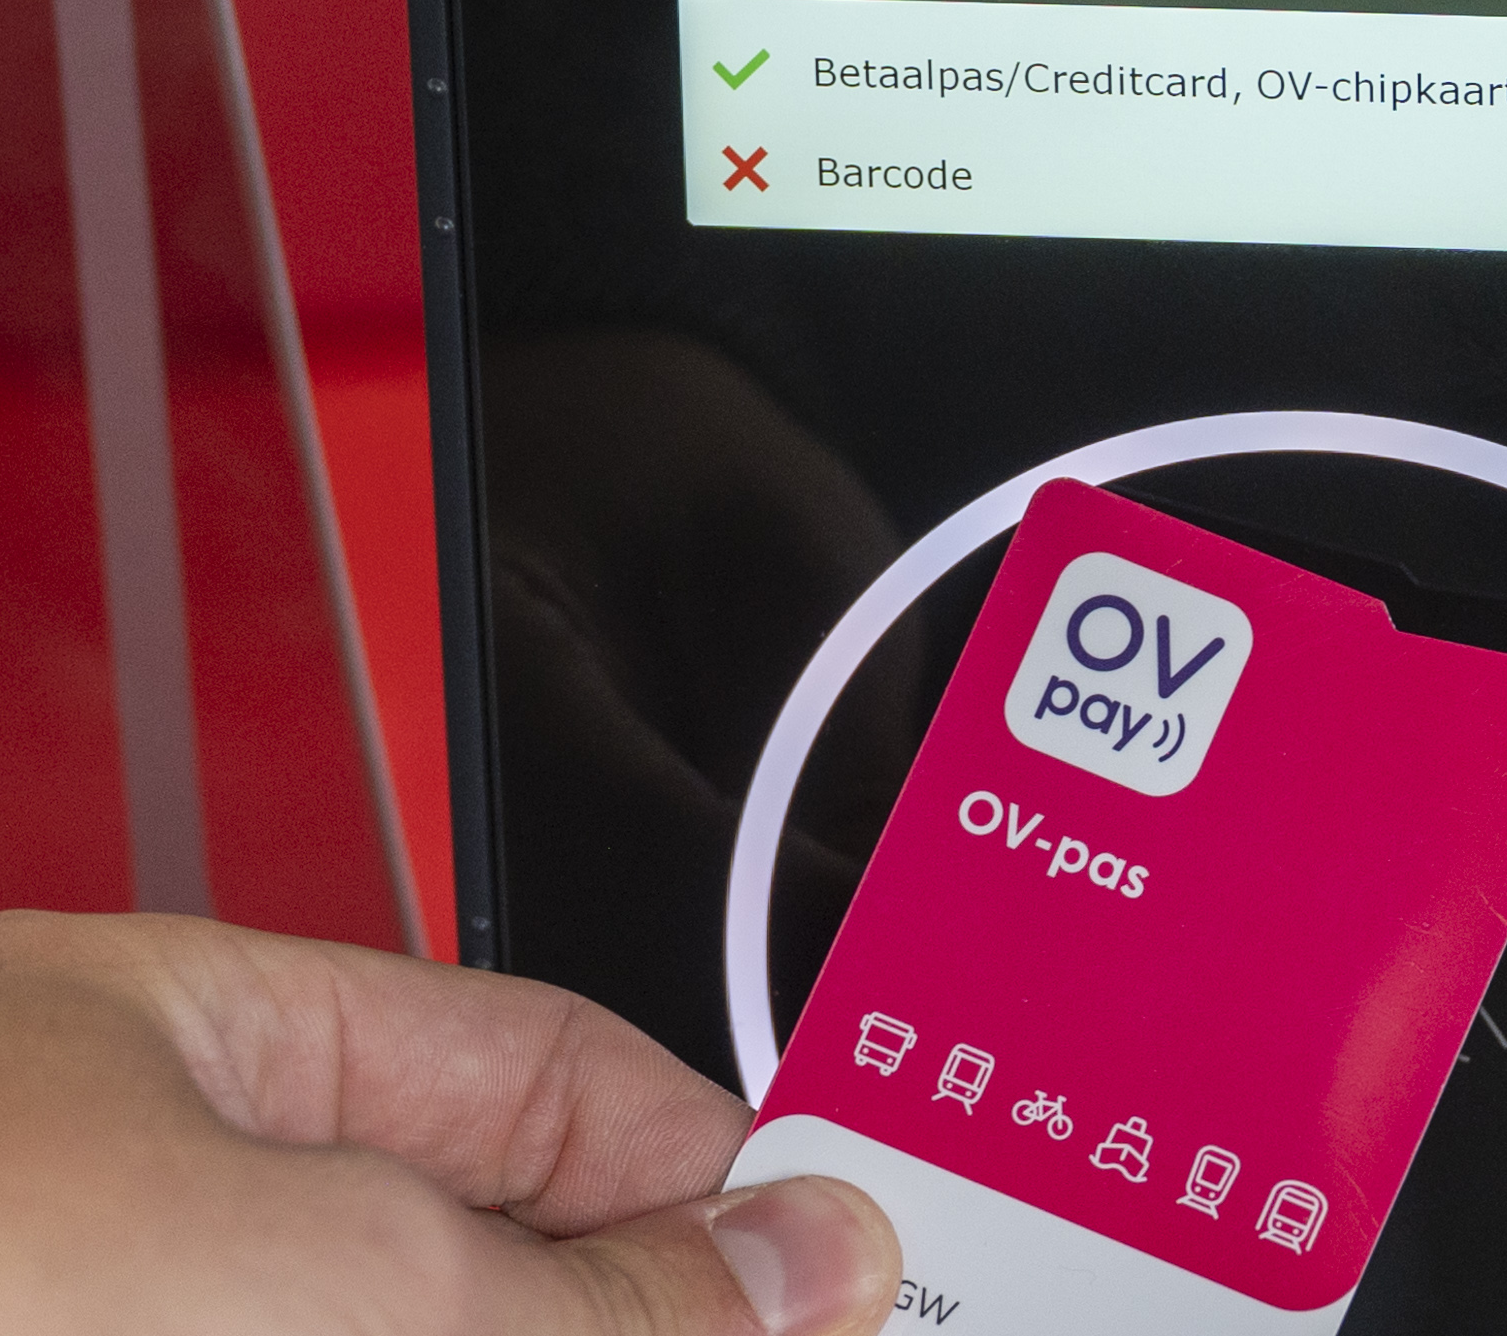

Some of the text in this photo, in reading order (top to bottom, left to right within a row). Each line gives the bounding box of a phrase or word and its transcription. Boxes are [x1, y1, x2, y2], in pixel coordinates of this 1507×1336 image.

[813, 56, 1242, 107] Betaalpas/Creditcard,
[817, 156, 974, 192] Barcode
[1064, 592, 1227, 701] OV
[1032, 673, 1154, 753] pay
[957, 789, 1151, 900] OV-pas
